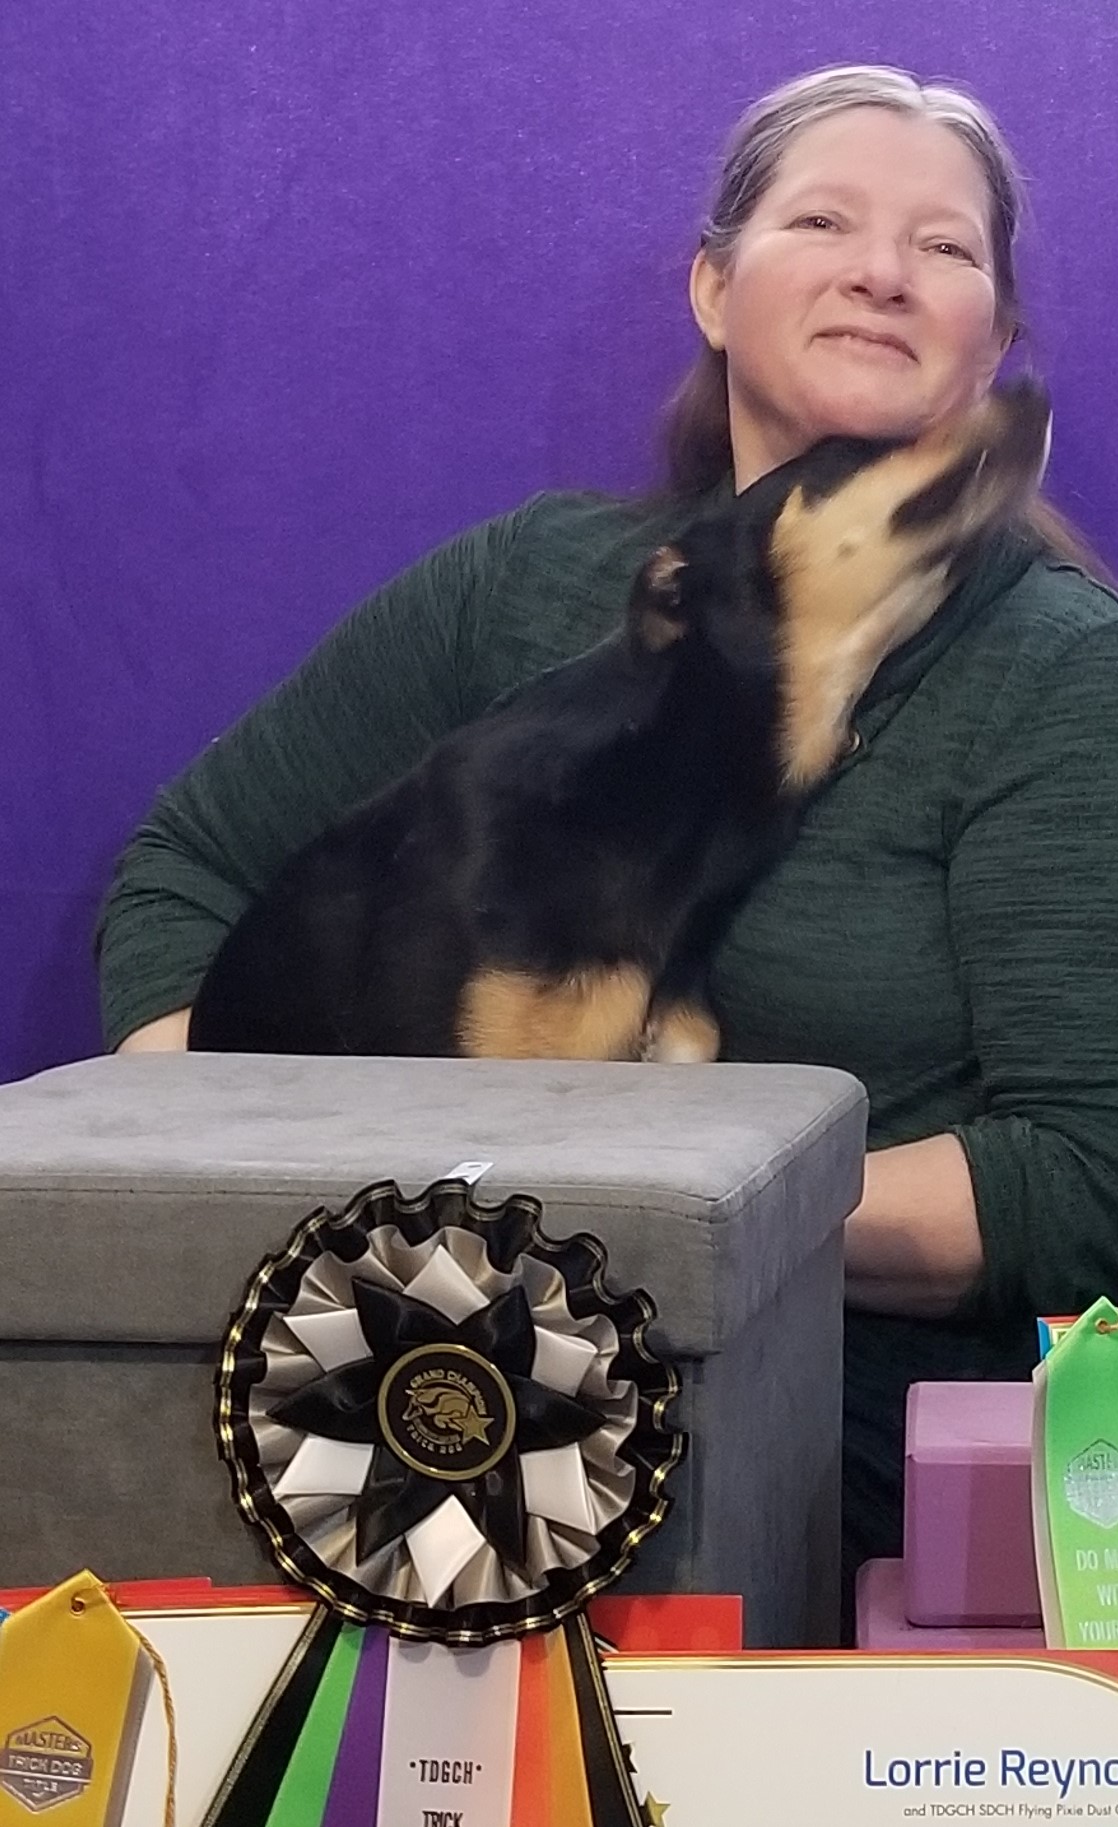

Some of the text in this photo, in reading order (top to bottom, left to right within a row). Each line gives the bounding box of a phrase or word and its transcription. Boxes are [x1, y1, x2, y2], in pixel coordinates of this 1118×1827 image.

[1076, 1549, 1098, 1571] DO
[15, 1731, 82, 1752] MASTERS
[51, 1759, 83, 1776] DOG
[864, 1750, 986, 1786] Lorrie
[421, 1810, 464, 1827] TRICK
[904, 1804, 926, 1816] and
[930, 1804, 975, 1816] TDGCH
[979, 1804, 1014, 1816] SDCH
[1018, 1803, 1052, 1819] Flying
[1056, 1804, 1083, 1816] Pixie
[1088, 1804, 1111, 1816] Dust
